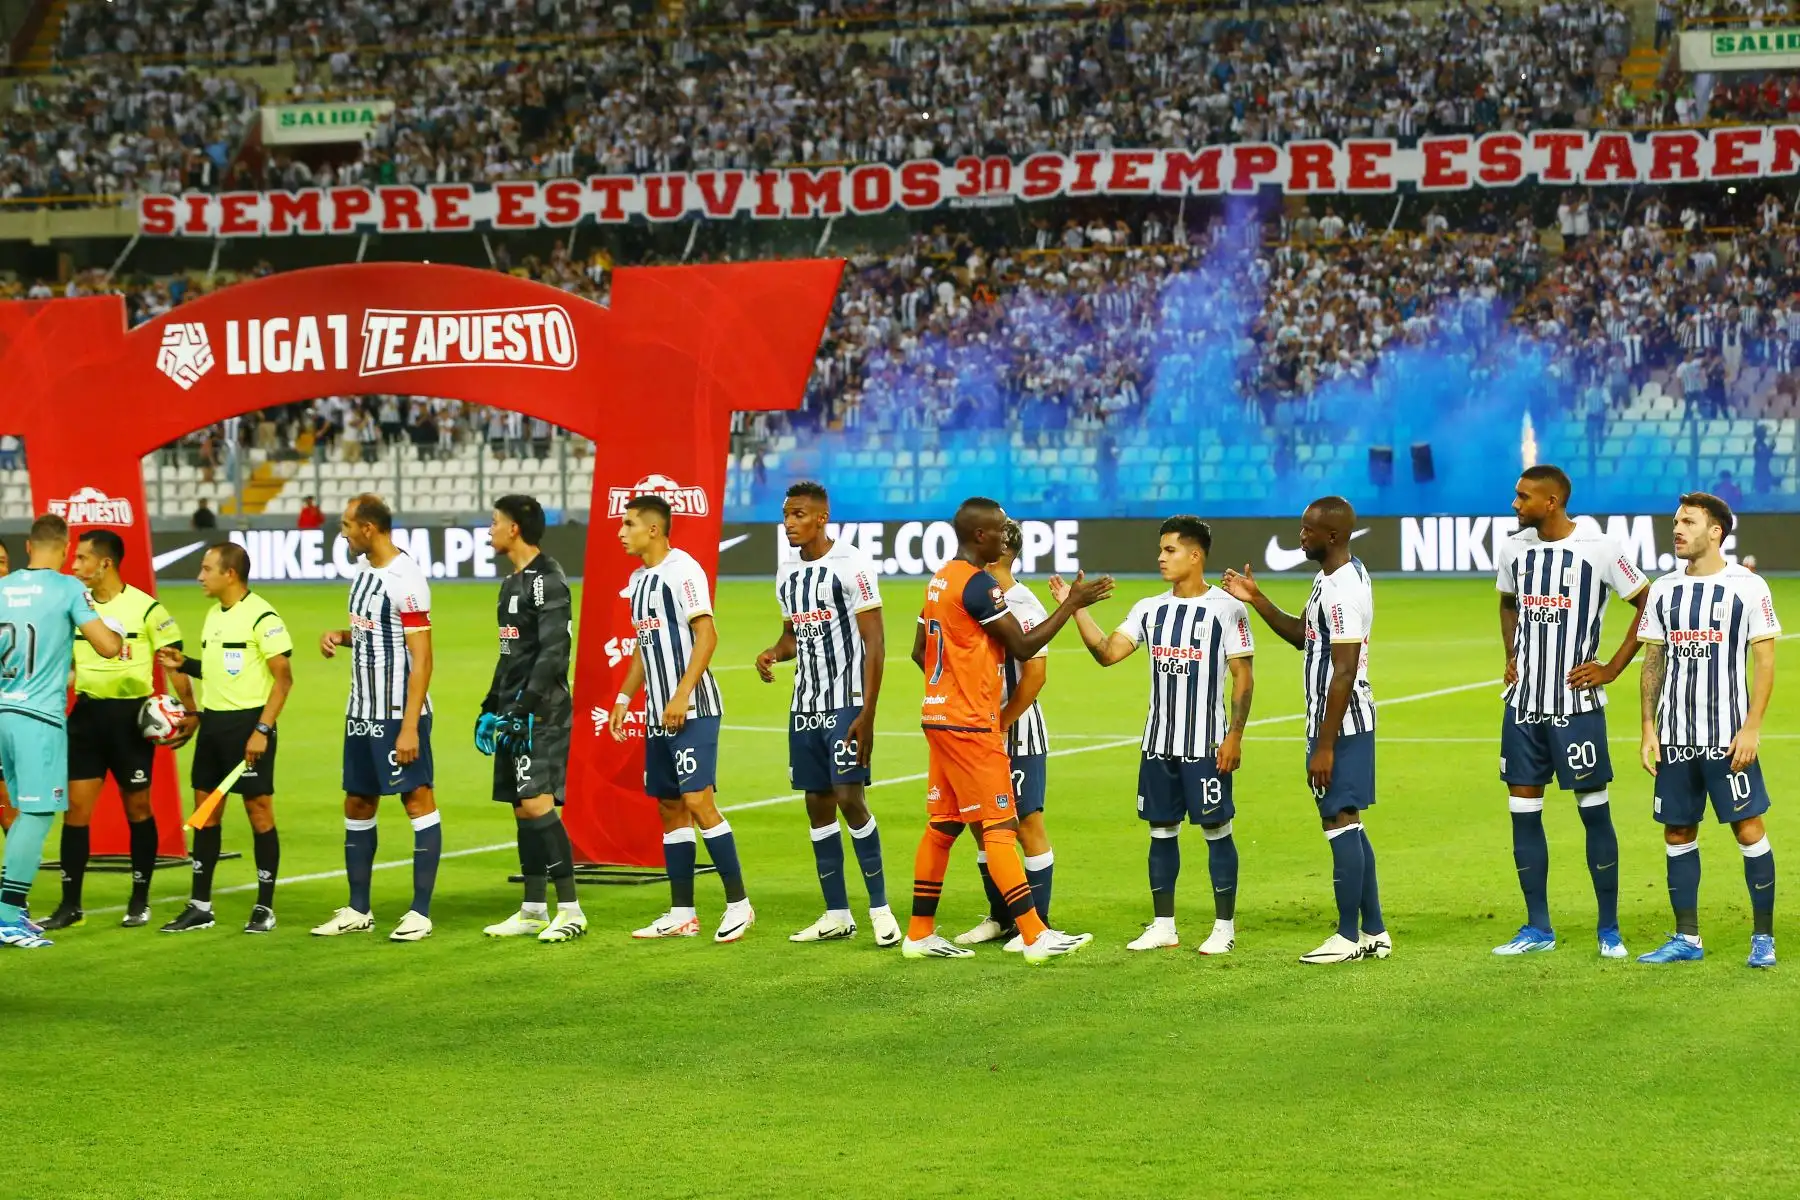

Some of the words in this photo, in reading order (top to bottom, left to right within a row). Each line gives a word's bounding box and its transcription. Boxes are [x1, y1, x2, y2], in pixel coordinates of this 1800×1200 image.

[280, 108, 374, 127] SALIDA
[141, 184, 473, 235] SIEMPRE
[495, 158, 941, 228] ESTUVIMOS
[955, 155, 1011, 197] 30
[1022, 141, 1394, 199] SIEMPRE
[365, 316, 404, 368] TE
[410, 310, 573, 366] APUESTO
[67, 500, 131, 523] APUESTO
[1616, 558, 1636, 584] TORITO
[855, 573, 869, 601] TORITO
[1522, 594, 1572, 609] apuesta
[1529, 608, 1560, 624] total
[1670, 629, 1723, 645] apuesta
[0, 622, 36, 680] 21
[1151, 645, 1203, 661] apuesta
[1678, 645, 1711, 658] total
[1157, 659, 1189, 674] total
[675, 747, 697, 775] 26
[1566, 740, 1597, 770] 20
[1200, 777, 1222, 805] 13
[1725, 771, 1751, 801] 10
